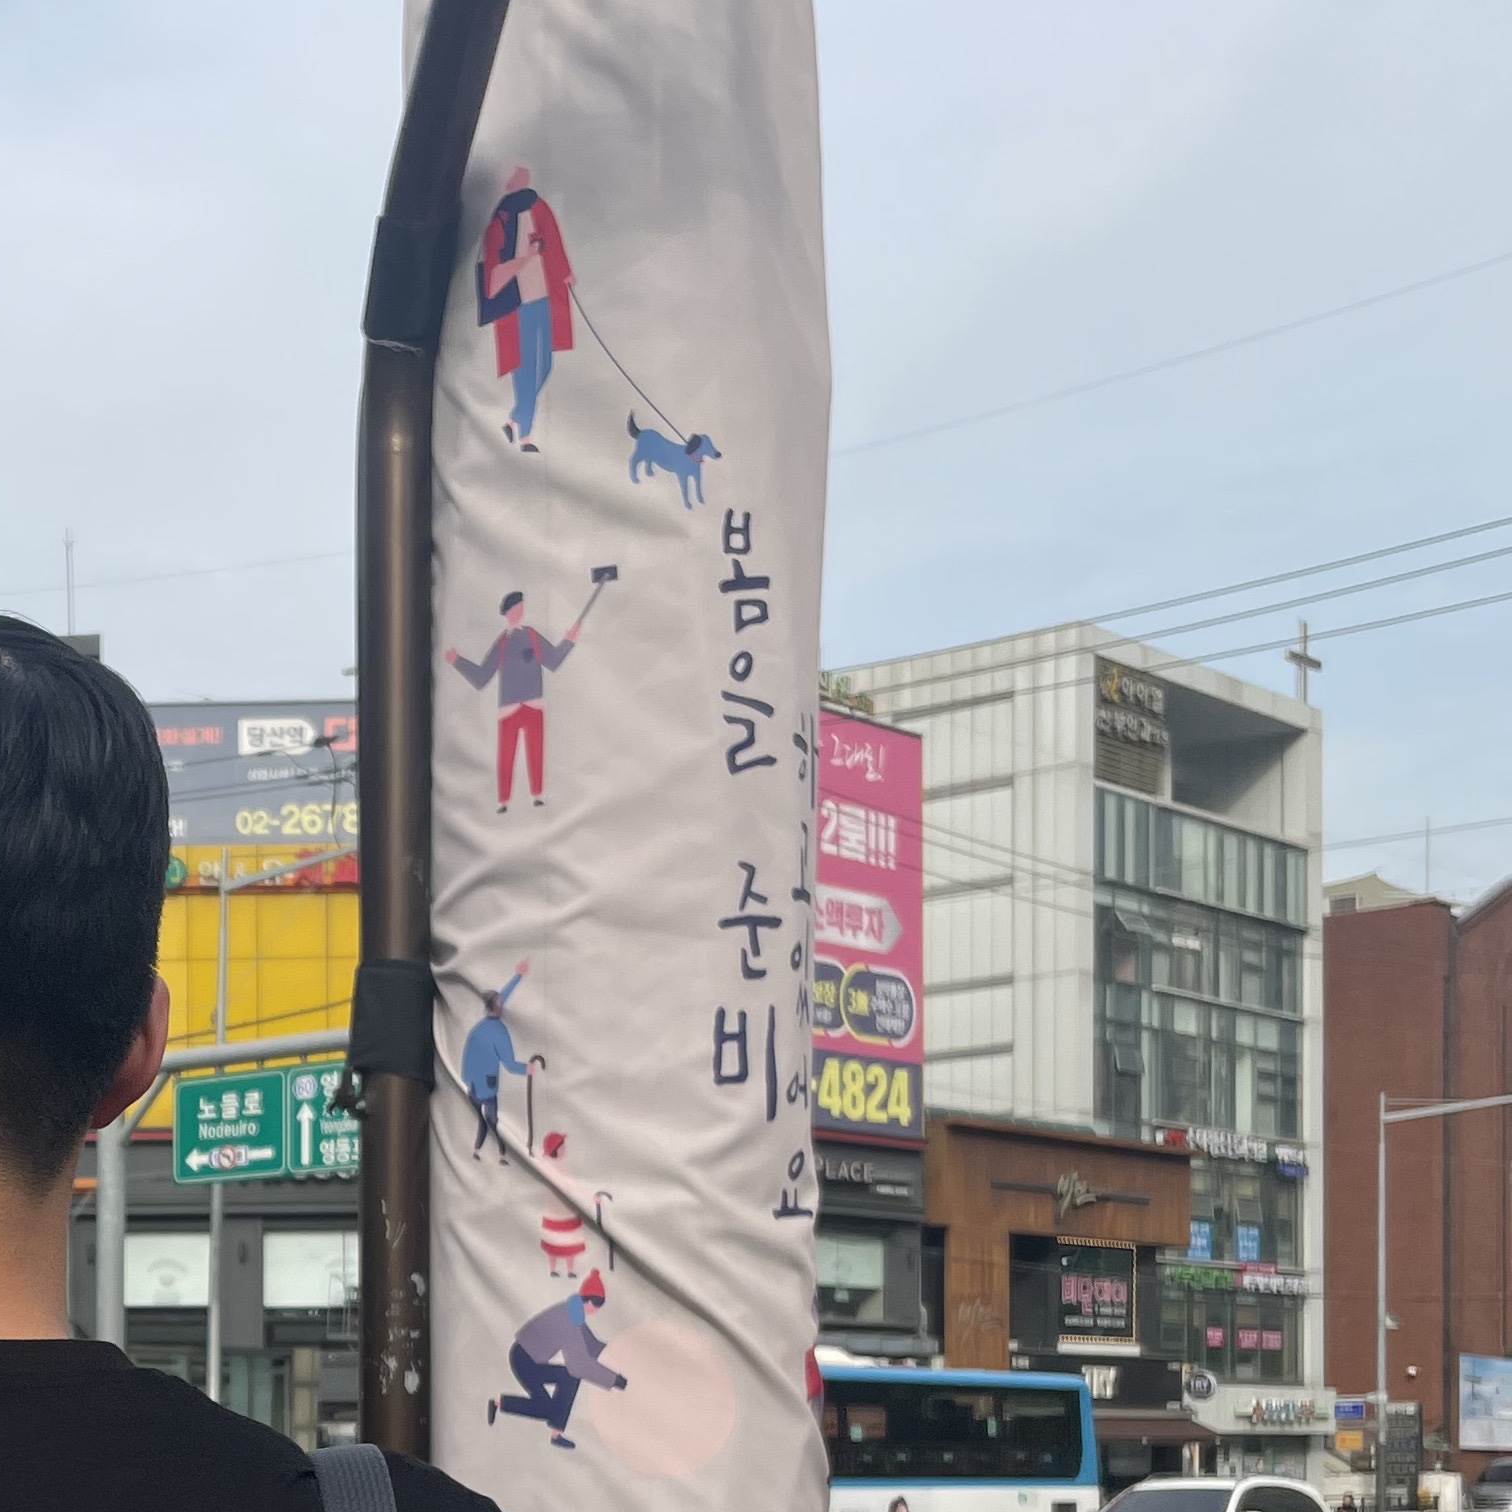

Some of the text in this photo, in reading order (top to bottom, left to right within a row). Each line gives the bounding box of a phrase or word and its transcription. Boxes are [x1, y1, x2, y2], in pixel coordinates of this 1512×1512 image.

[713, 860, 783, 1122] 준비
[197, 1089, 264, 1120] 노들로
[199, 1122, 258, 1140] Nodeulro
